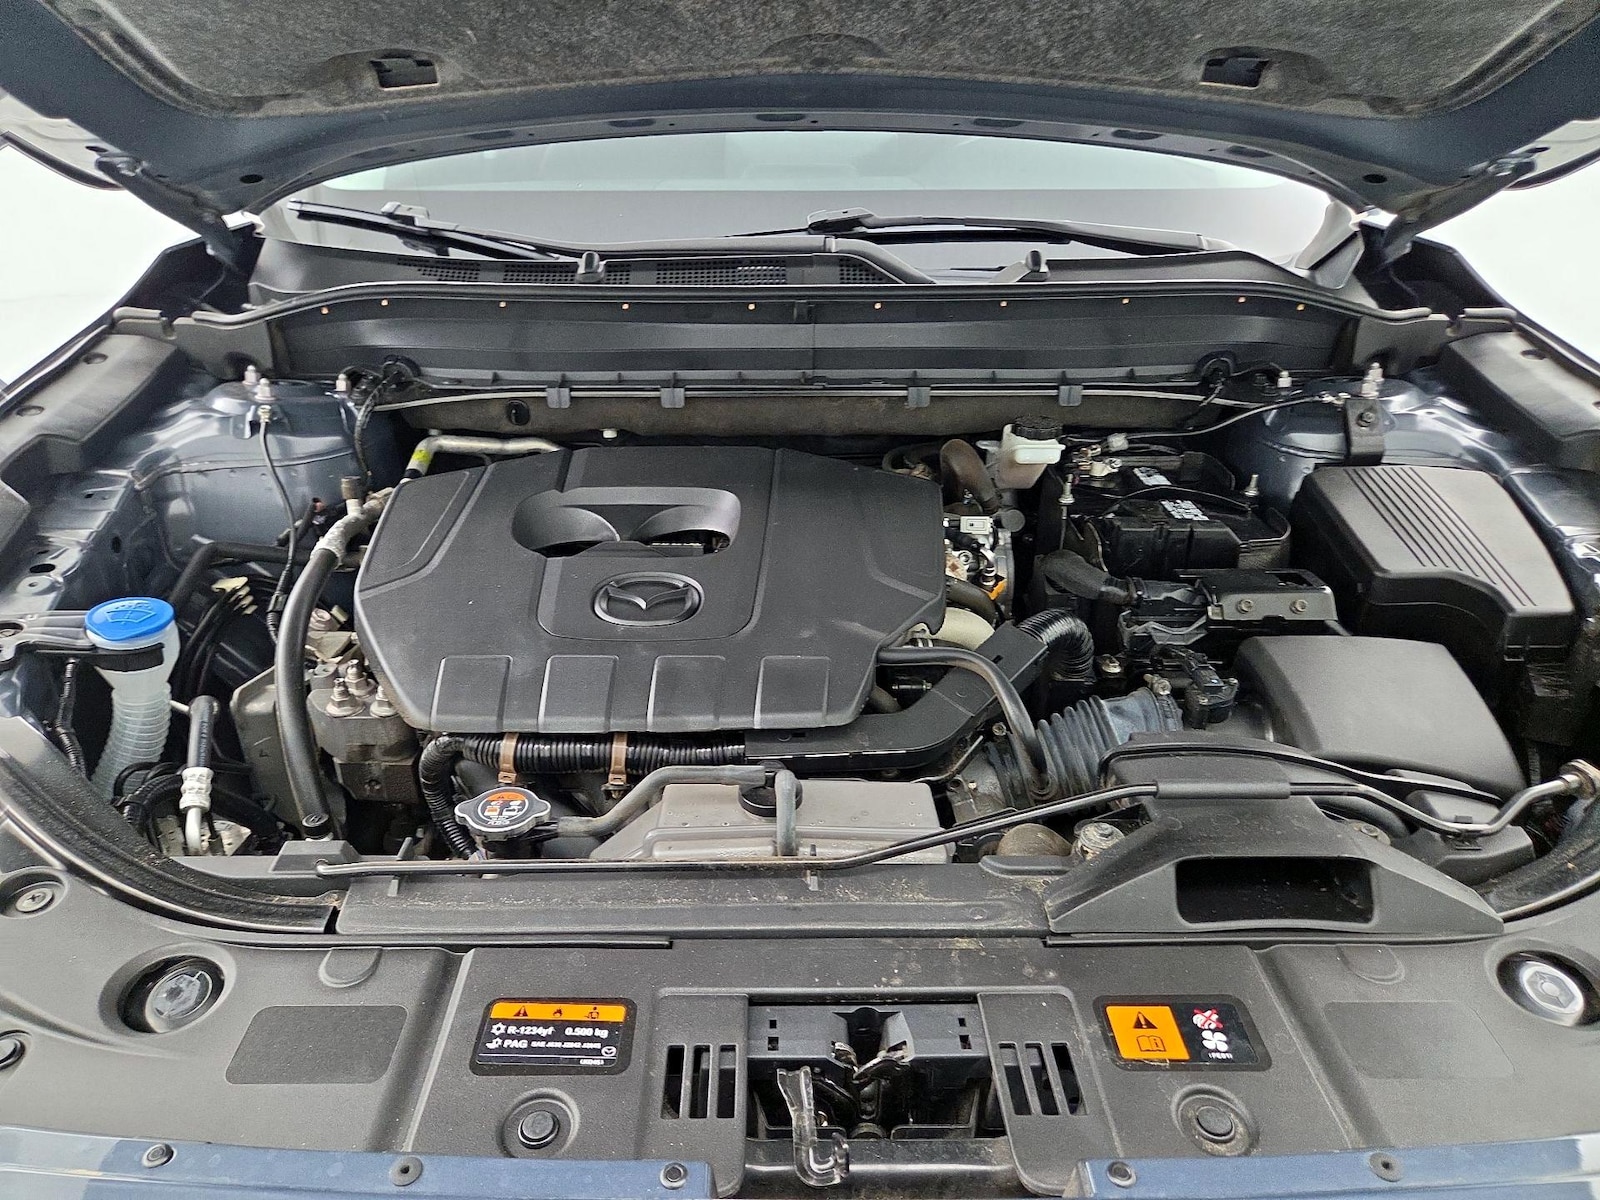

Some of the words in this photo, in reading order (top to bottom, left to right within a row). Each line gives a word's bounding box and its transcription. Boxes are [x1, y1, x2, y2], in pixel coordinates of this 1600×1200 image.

[507, 1026, 555, 1037] R-1234yf
[564, 1027, 593, 1036] 0.500
[594, 1028, 609, 1039] kg
[503, 1039, 528, 1048] PAG
